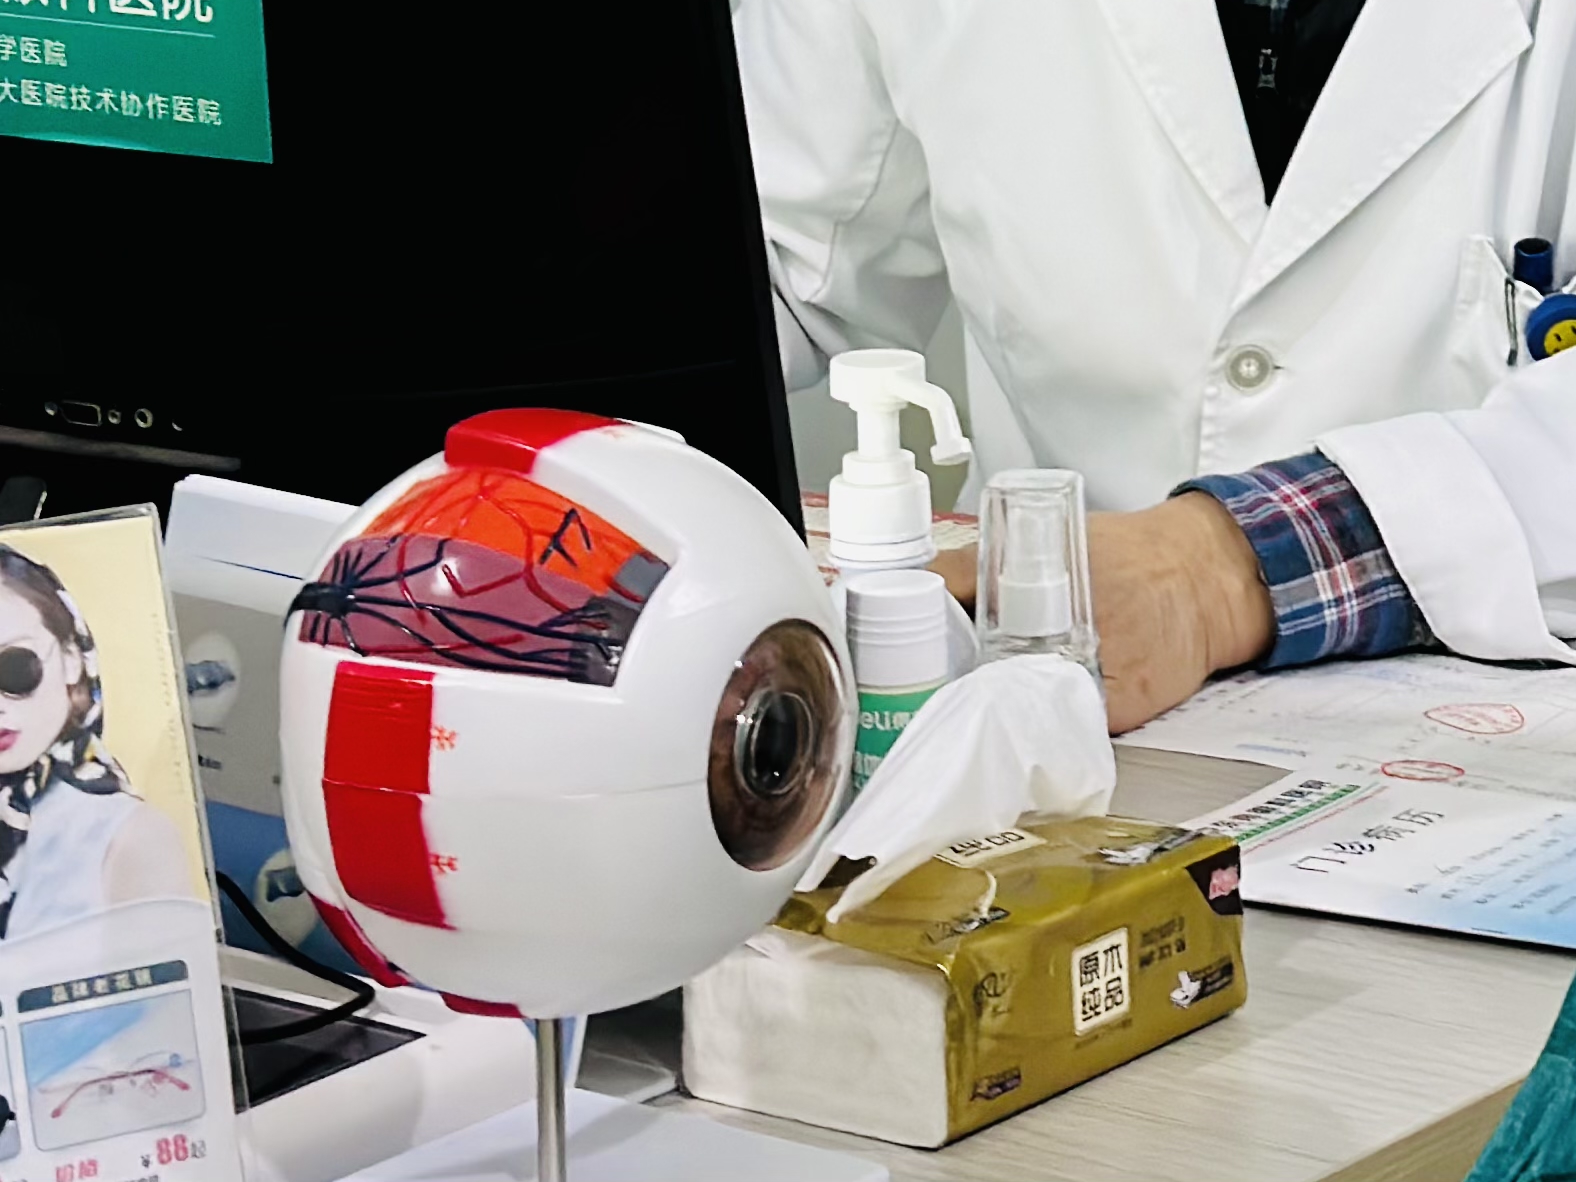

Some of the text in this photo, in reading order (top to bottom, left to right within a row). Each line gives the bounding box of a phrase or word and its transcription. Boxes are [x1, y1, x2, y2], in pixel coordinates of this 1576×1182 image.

[0, 78, 222, 125] 大医院技术协作医院
